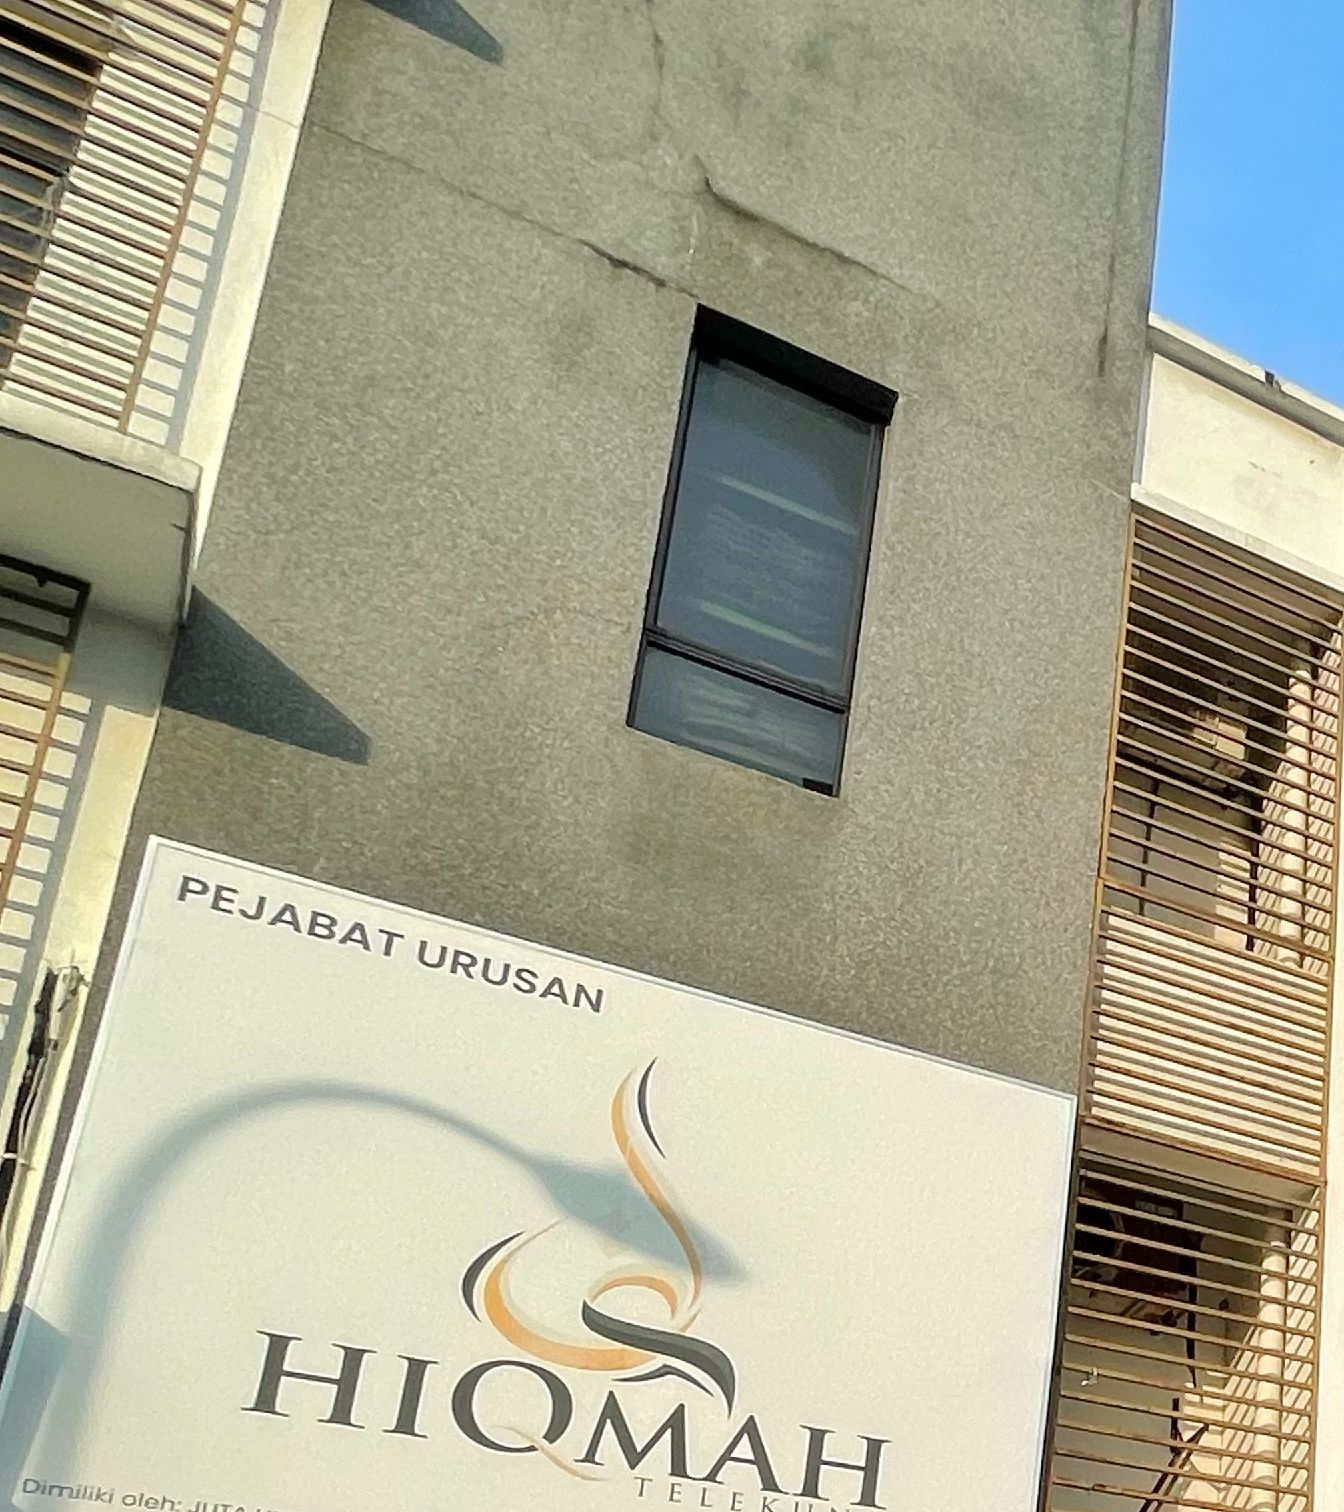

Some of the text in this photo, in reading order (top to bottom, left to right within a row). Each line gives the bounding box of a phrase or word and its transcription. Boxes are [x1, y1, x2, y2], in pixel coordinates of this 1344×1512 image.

[178, 874, 605, 1014] PEJABAT URUSAN
[241, 1330, 892, 1511] HIQMAH
[22, 1478, 114, 1505] Dimiliki
[122, 1492, 182, 1512] oleh:
